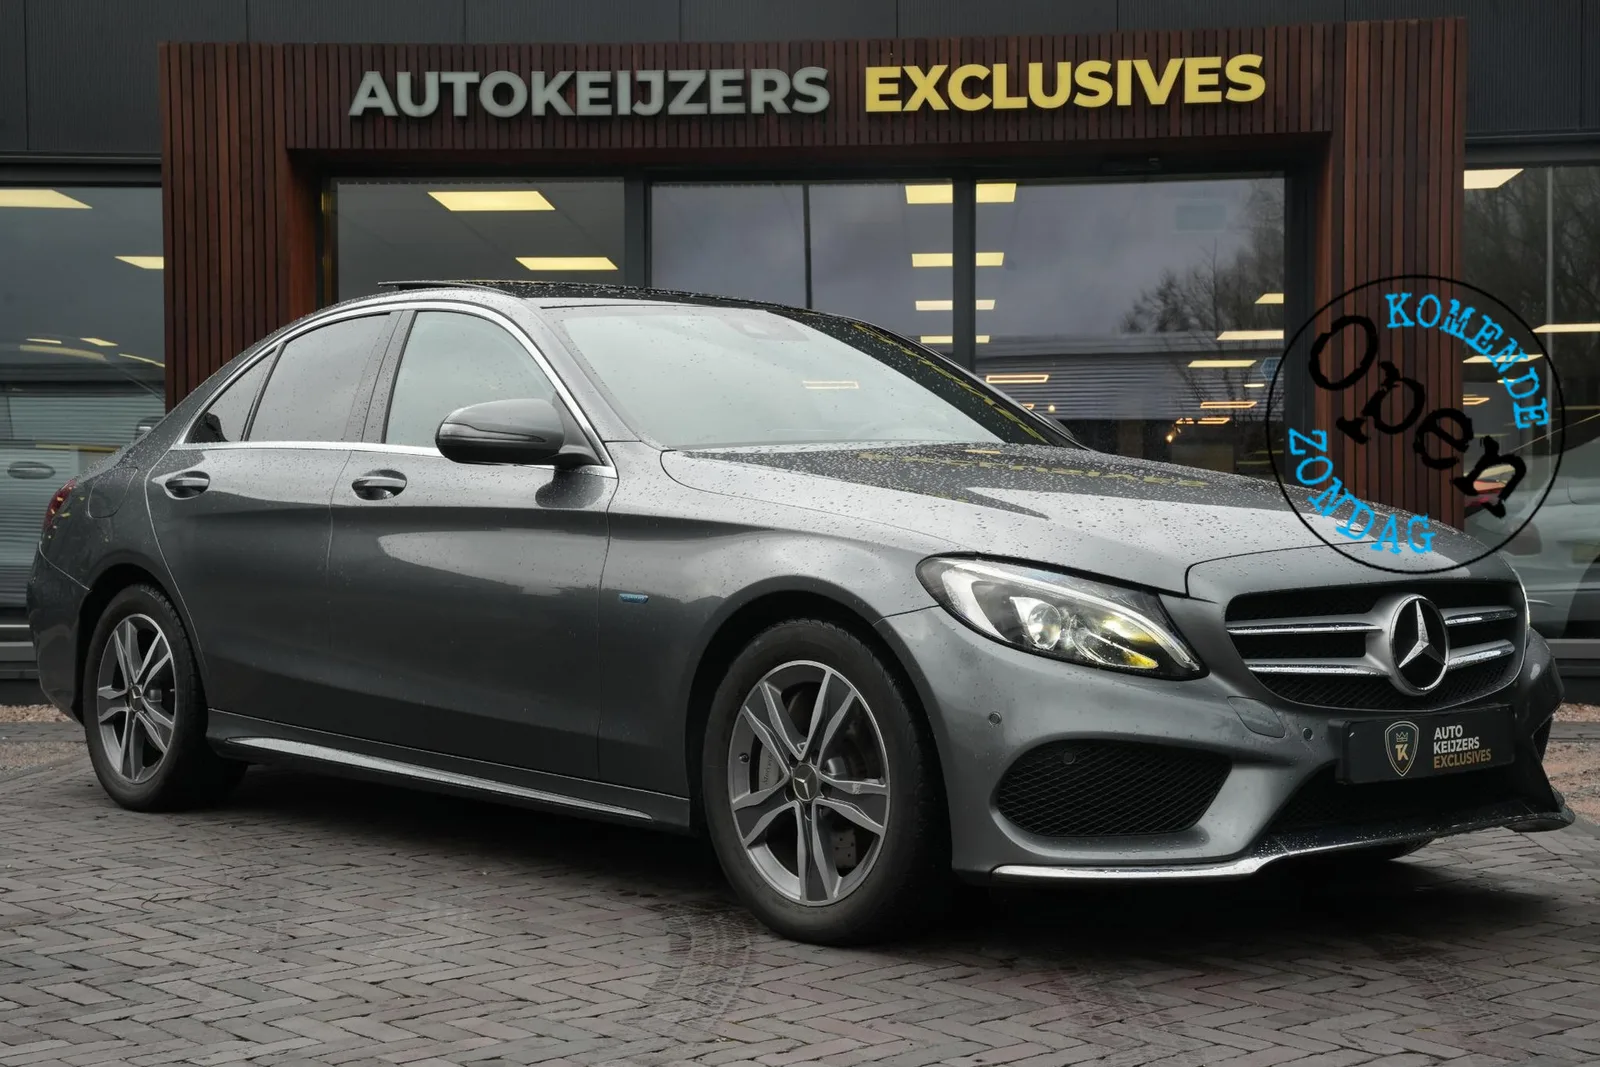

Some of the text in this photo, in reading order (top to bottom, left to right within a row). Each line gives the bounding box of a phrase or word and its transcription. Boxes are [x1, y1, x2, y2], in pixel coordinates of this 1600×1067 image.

[348, 53, 1266, 118] AUTOKEIJZERS EXCLUSIVES
[1434, 725, 1463, 740] AUTO
[1433, 737, 1480, 754] KEIJZERS
[1433, 749, 1492, 769] EXCLUSIVES
